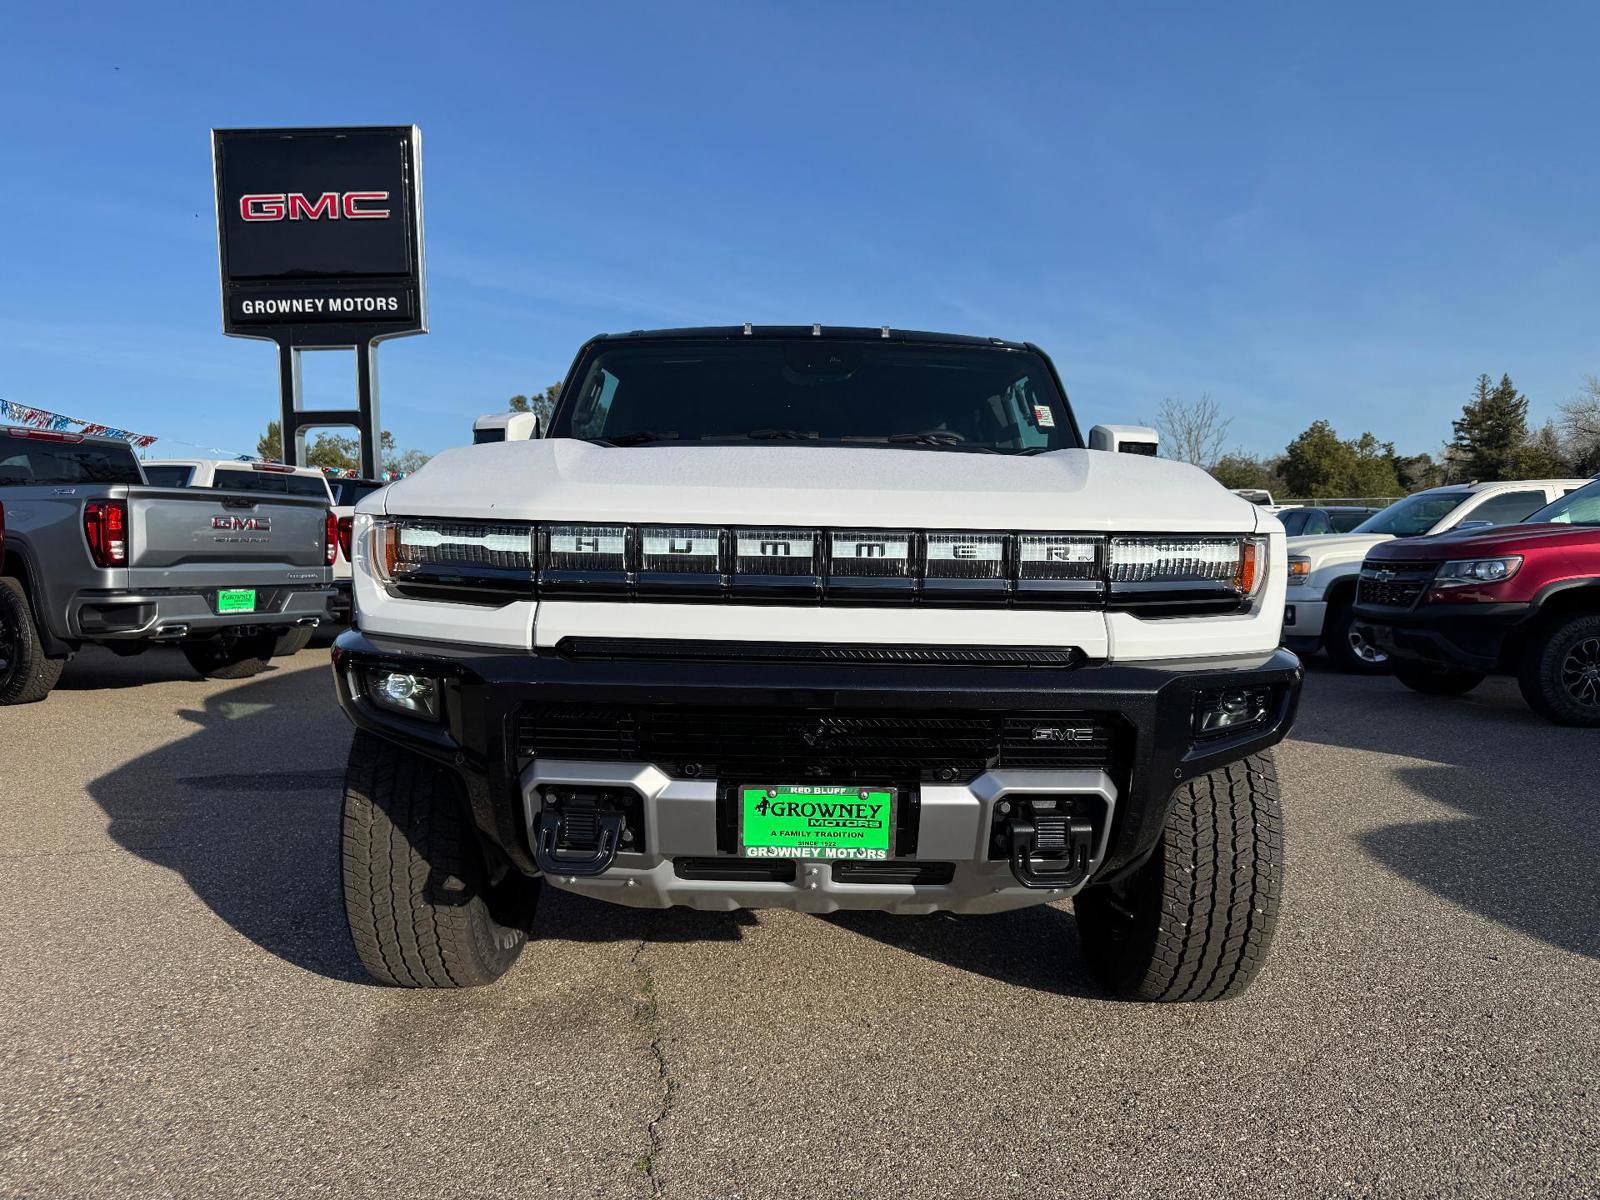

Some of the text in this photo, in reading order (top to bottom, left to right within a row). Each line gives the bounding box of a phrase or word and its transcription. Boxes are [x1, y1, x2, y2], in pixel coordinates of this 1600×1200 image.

[240, 192, 390, 221] GMC
[242, 297, 398, 314] GROWNEY MOTORS
[212, 515, 272, 532] GMC
[576, 536, 1070, 561] HUMMER
[1031, 728, 1094, 741] GMC
[814, 787, 846, 795] BLUFF
[771, 802, 883, 819] GROWNEY
[810, 820, 880, 828] MOTORS
[779, 830, 811, 838] FAMILY
[747, 846, 887, 859] GROWNEY MOTORS
